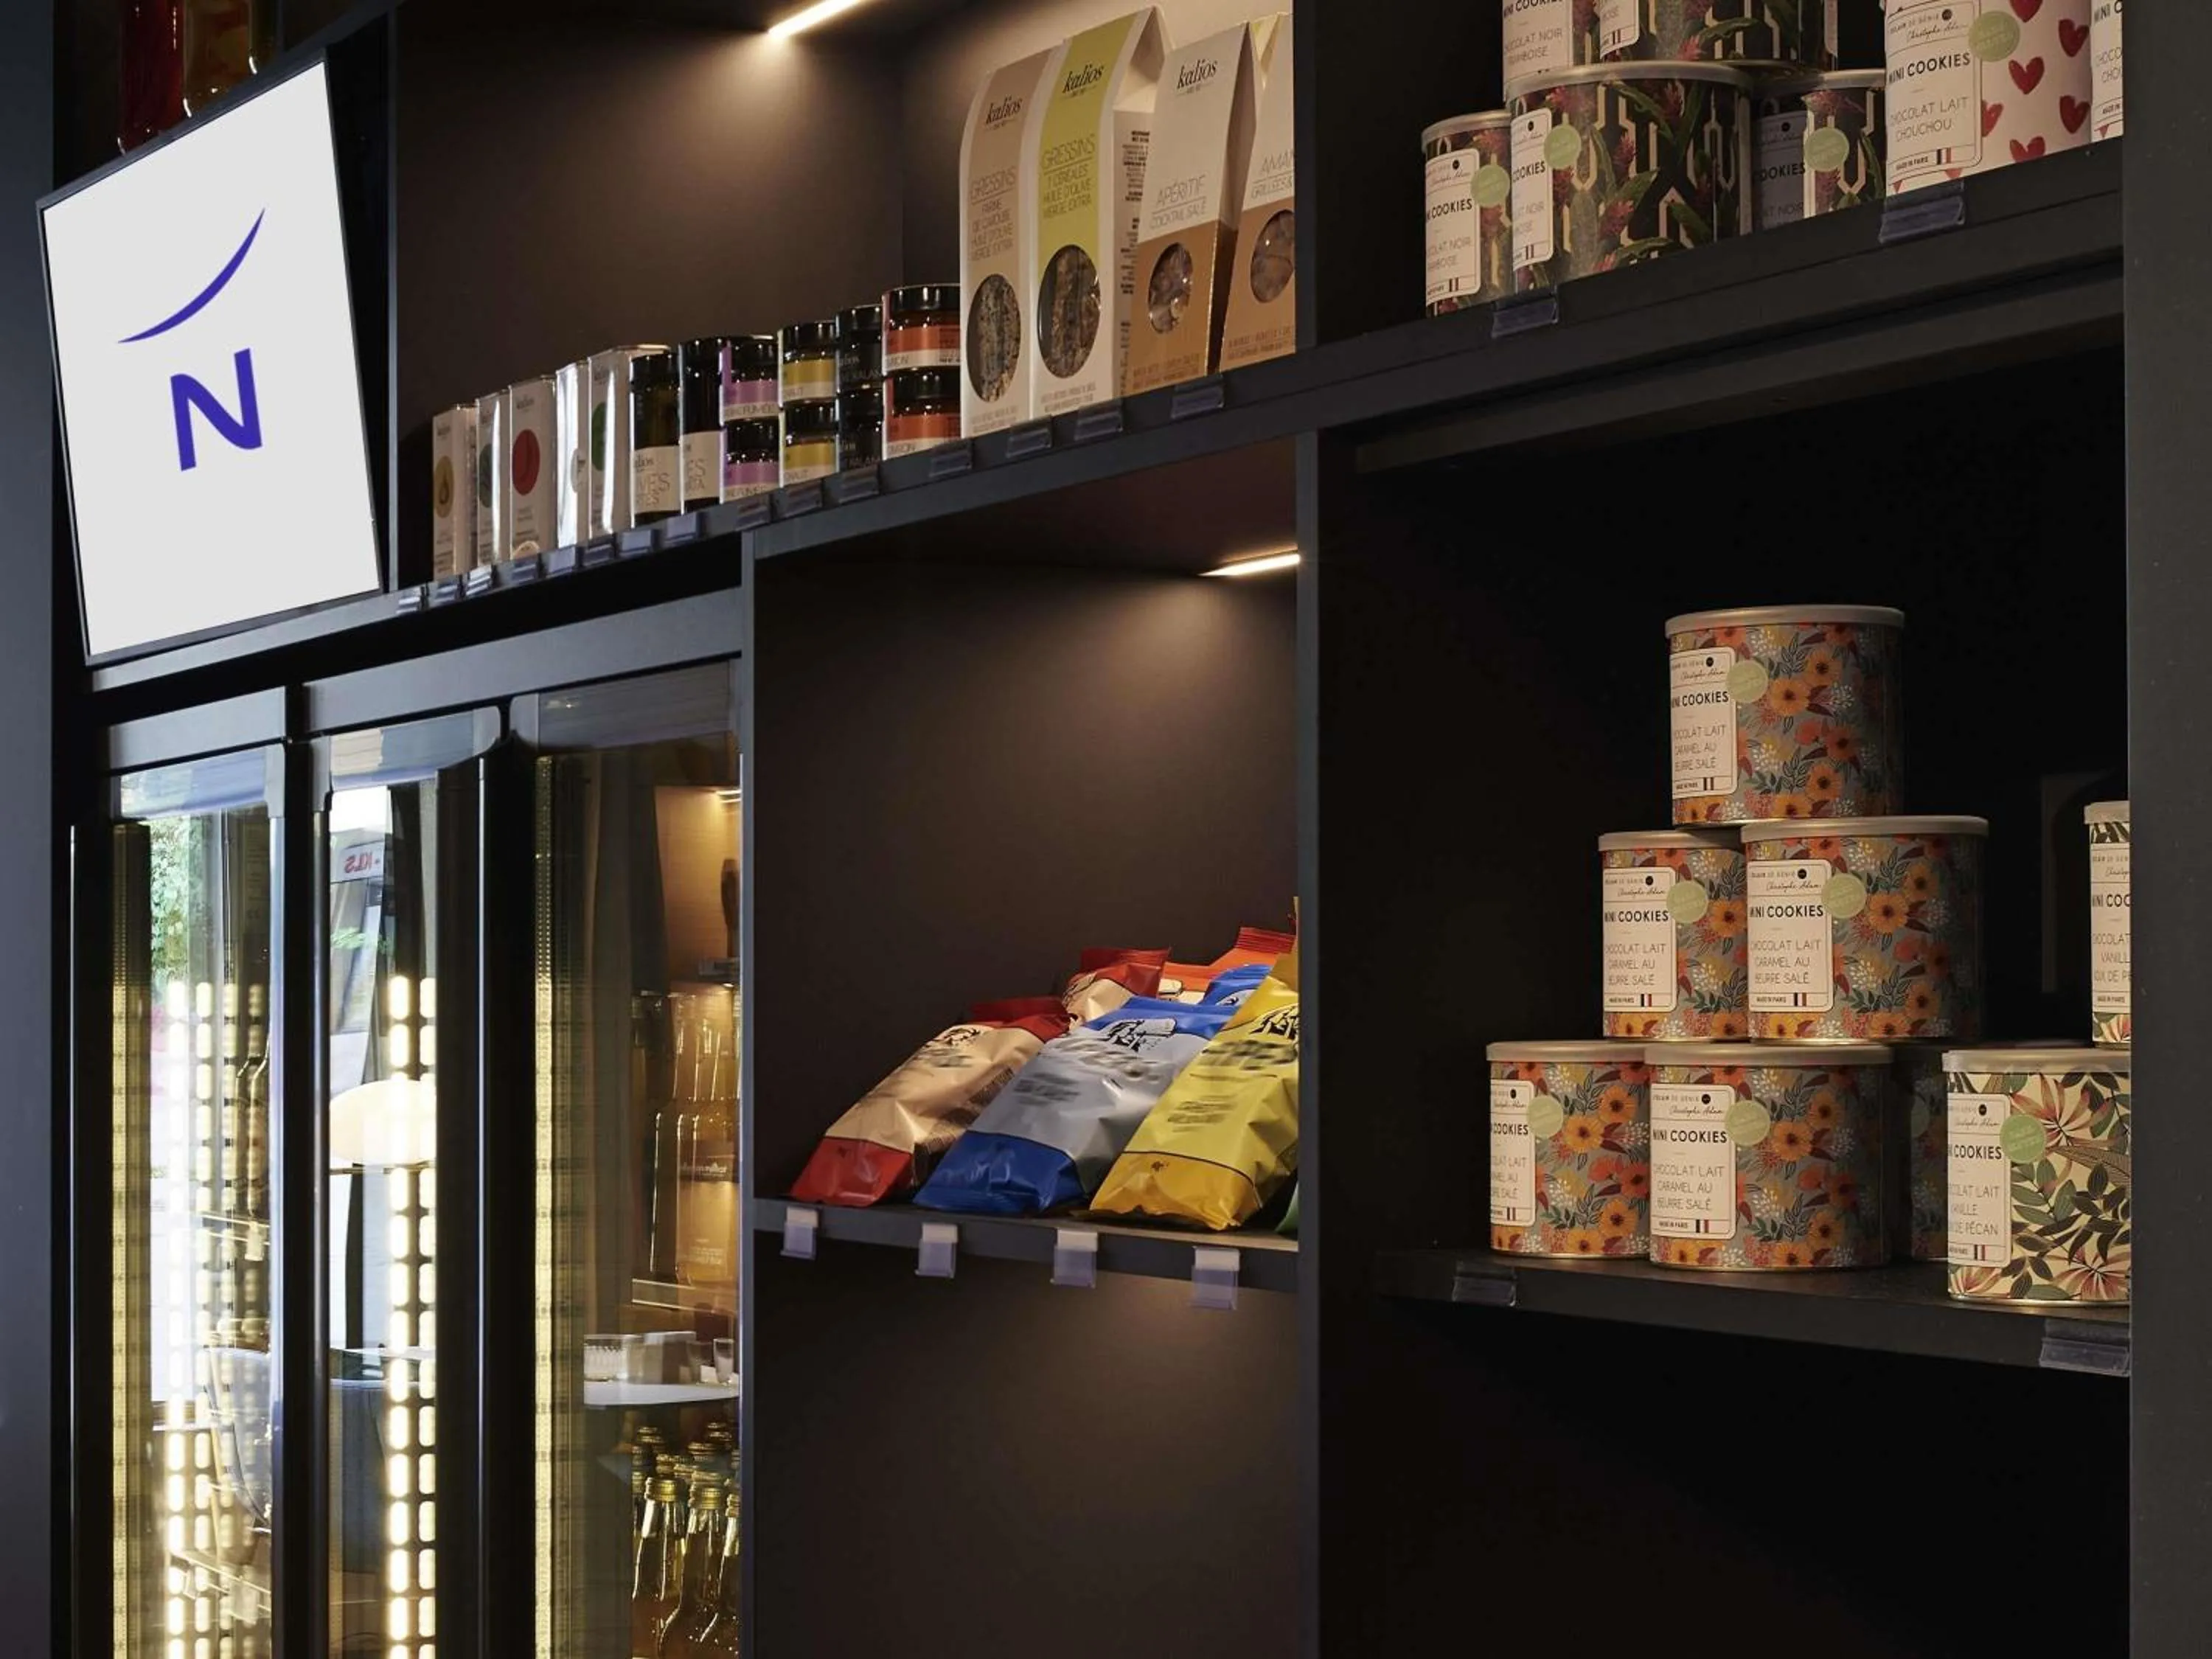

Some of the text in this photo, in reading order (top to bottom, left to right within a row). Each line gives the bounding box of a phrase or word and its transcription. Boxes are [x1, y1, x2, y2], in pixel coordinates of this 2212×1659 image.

[1907, 52, 1971, 77] COOKIES
[1062, 63, 1104, 94] kalios
[1178, 60, 1217, 89] kalios
[987, 94, 1023, 125] kalios
[1940, 97, 1969, 114] LAIT
[1896, 118, 1952, 142] CHOUCHOU
[1431, 198, 1472, 220] COOKIES
[170, 348, 262, 471] N
[1682, 691, 1729, 707] COOKIES
[1705, 724, 1728, 737] LAIT
[1705, 742, 1717, 751] AU
[1618, 911, 1669, 922] COOKIES
[1767, 905, 1823, 918] COOKIES
[1643, 943, 1666, 953] LAIT
[1795, 939, 1821, 950] LAIT
[1642, 959, 1655, 970] AU
[1794, 956, 1810, 967] AU
[1670, 1130, 1728, 1144] COOKIES
[1954, 1144, 2002, 1160] COOKIES
[1698, 1165, 1725, 1178] LAIT
[1697, 1181, 1713, 1194] AU
[1976, 1186, 2000, 1199] LAIT
[1686, 1197, 1711, 1211] SALÉ
